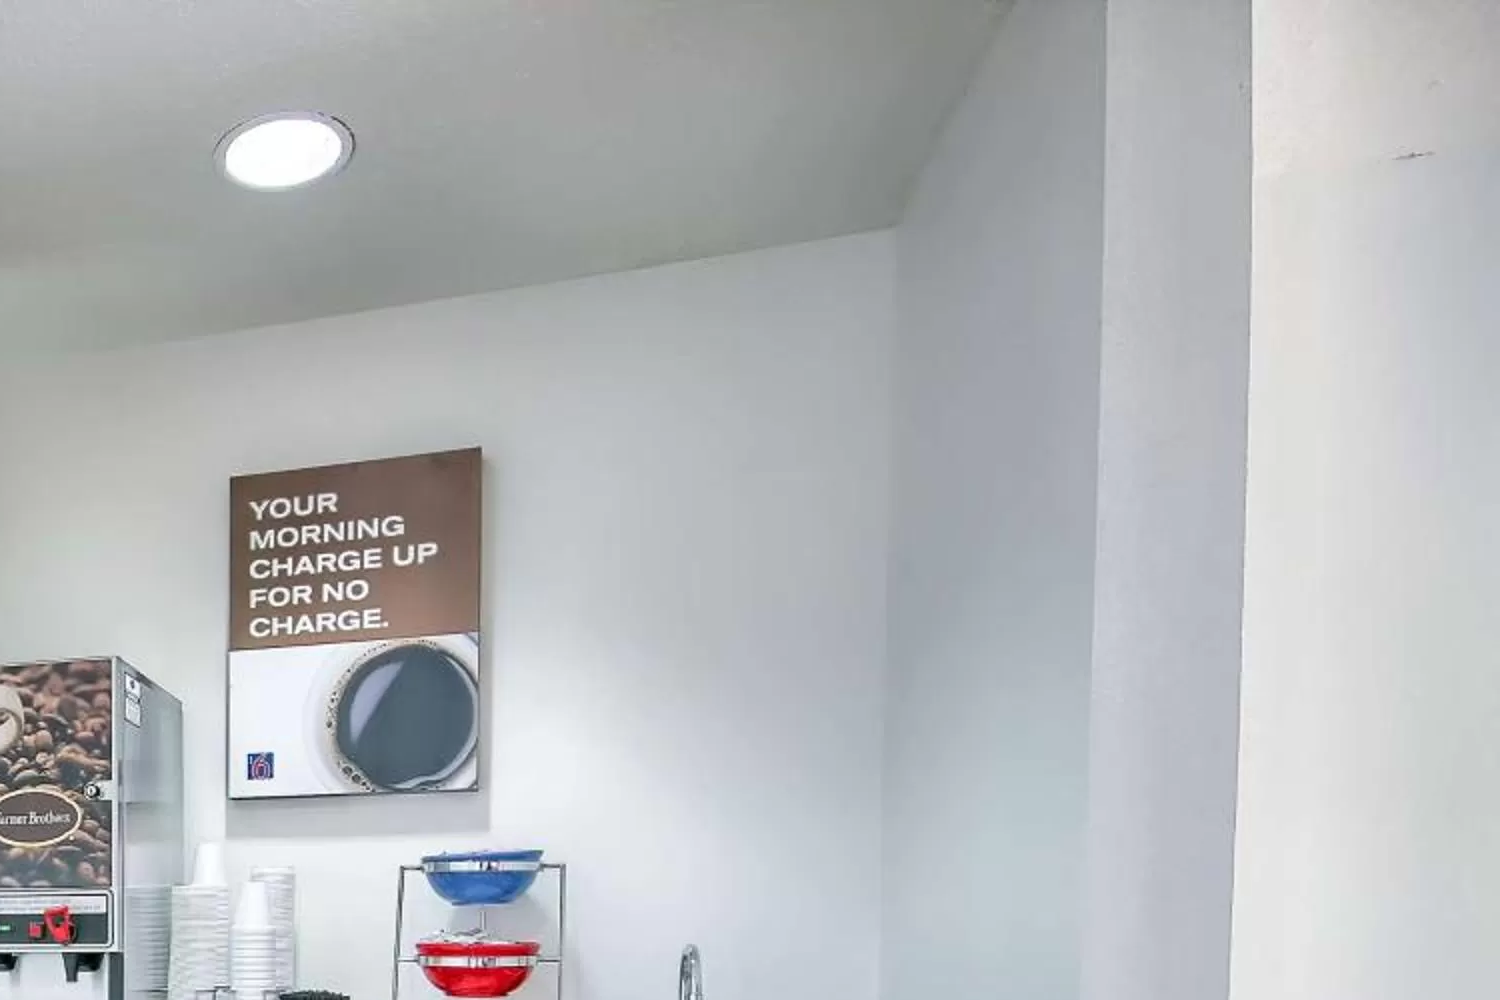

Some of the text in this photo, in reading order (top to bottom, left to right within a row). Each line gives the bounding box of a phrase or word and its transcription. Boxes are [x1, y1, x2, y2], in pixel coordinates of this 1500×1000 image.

[249, 492, 338, 521] YOUR
[249, 515, 405, 550] MORNING
[249, 542, 438, 579] CHARGE UP
[249, 579, 369, 609] FOR NO
[249, 607, 389, 638] CHARGE.
